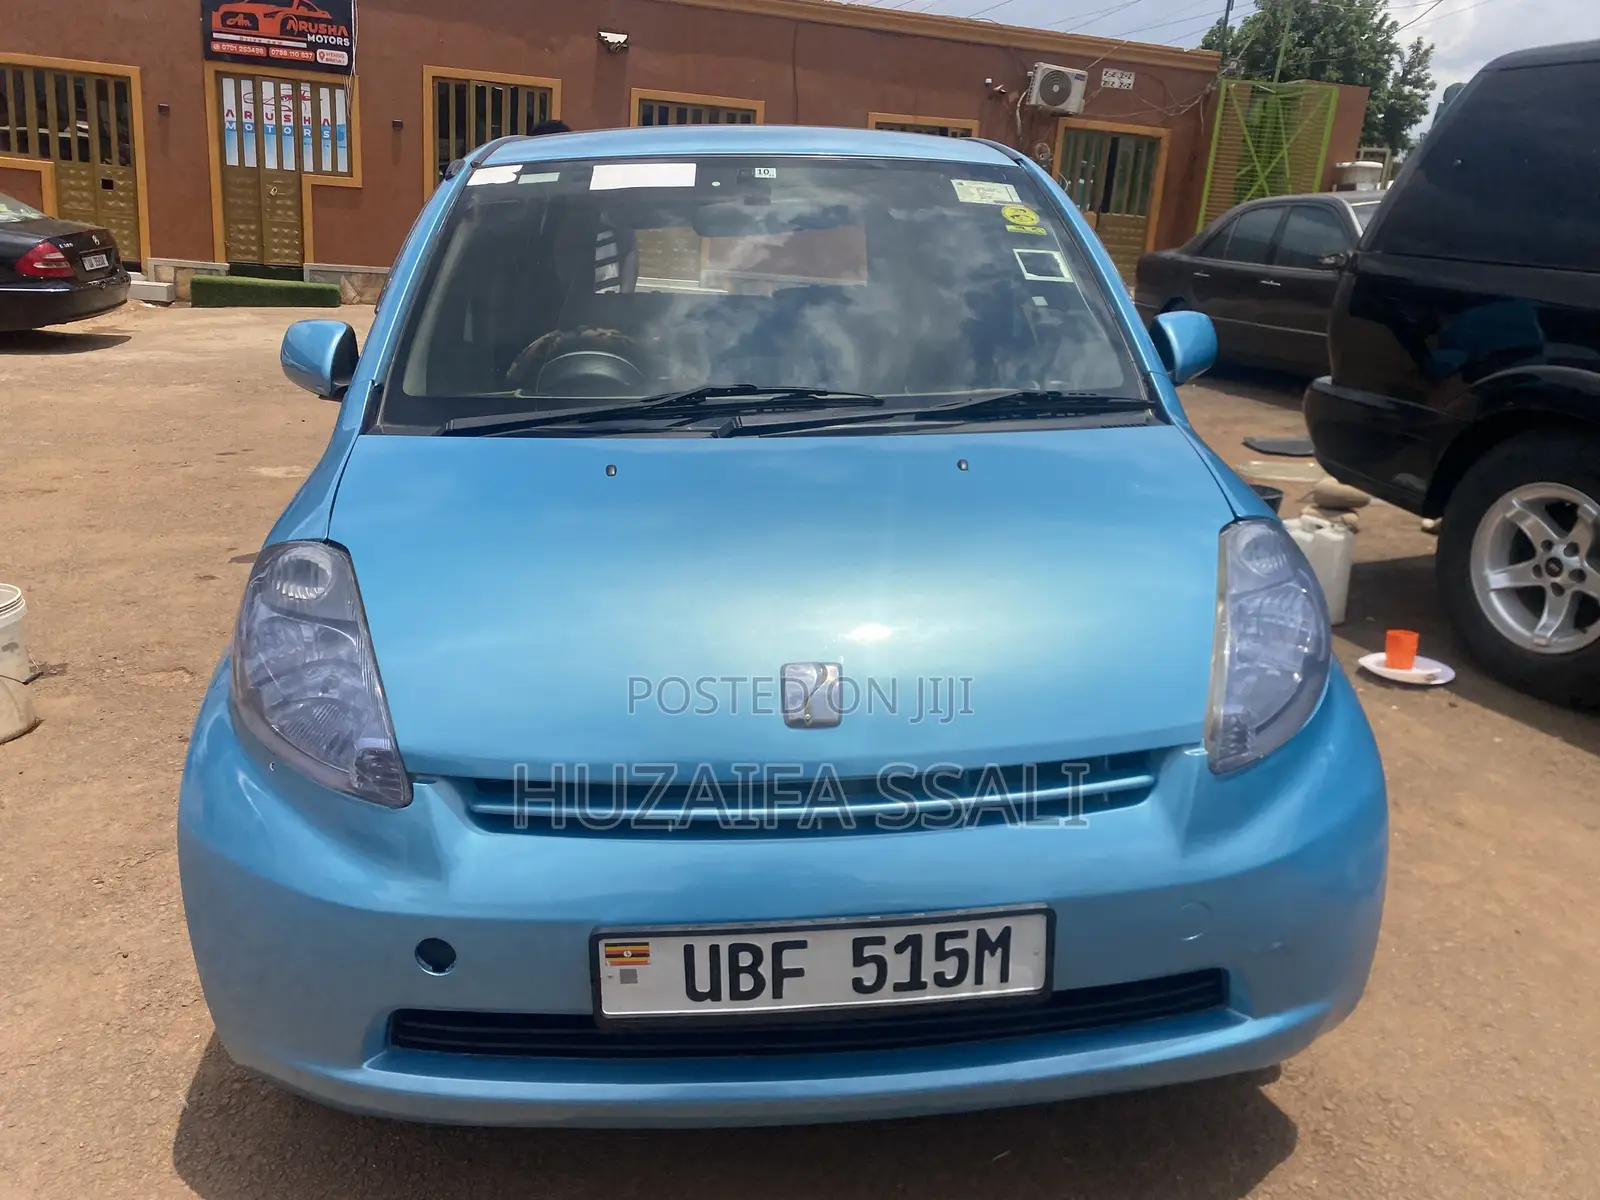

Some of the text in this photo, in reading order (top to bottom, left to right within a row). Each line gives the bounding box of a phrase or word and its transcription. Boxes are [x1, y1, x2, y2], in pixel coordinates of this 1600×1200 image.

[286, 19, 349, 36] ARUSHA
[306, 33, 350, 47] MOTORS
[225, 109, 330, 126] ARUSHA
[225, 123, 330, 138] MOTORS
[683, 925, 1013, 1003] UBF 515M
